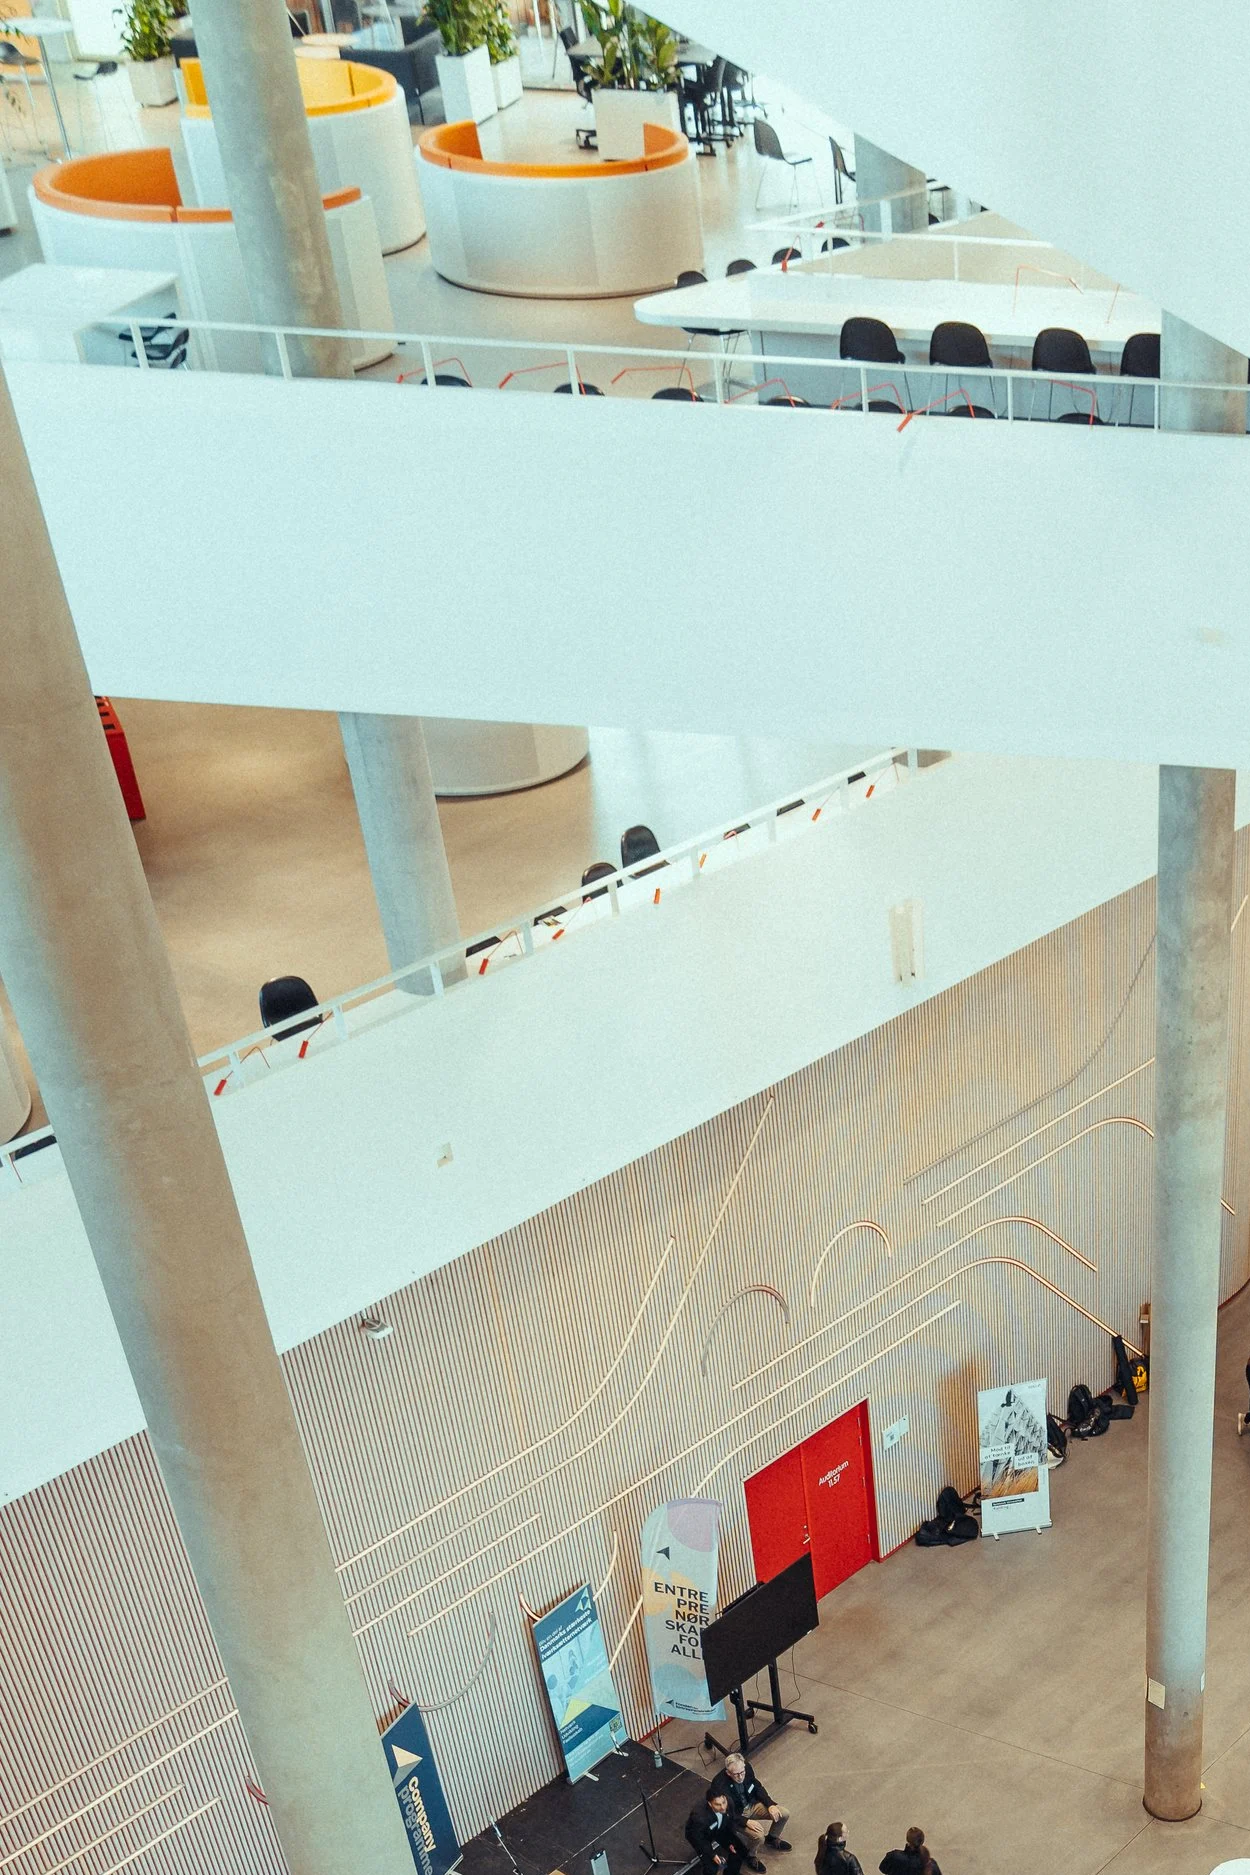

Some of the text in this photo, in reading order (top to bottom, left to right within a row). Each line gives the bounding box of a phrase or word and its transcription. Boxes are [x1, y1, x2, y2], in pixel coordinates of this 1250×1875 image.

[818, 1460, 850, 1487] Auditorium
[654, 1581, 709, 1602] ENTRE
[677, 1598, 710, 1616] PRE
[675, 1610, 710, 1627] NØR
[665, 1619, 704, 1637] SKA
[539, 1629, 566, 1651] Danmarks
[680, 1633, 700, 1647] FO
[671, 1644, 702, 1660] ALL
